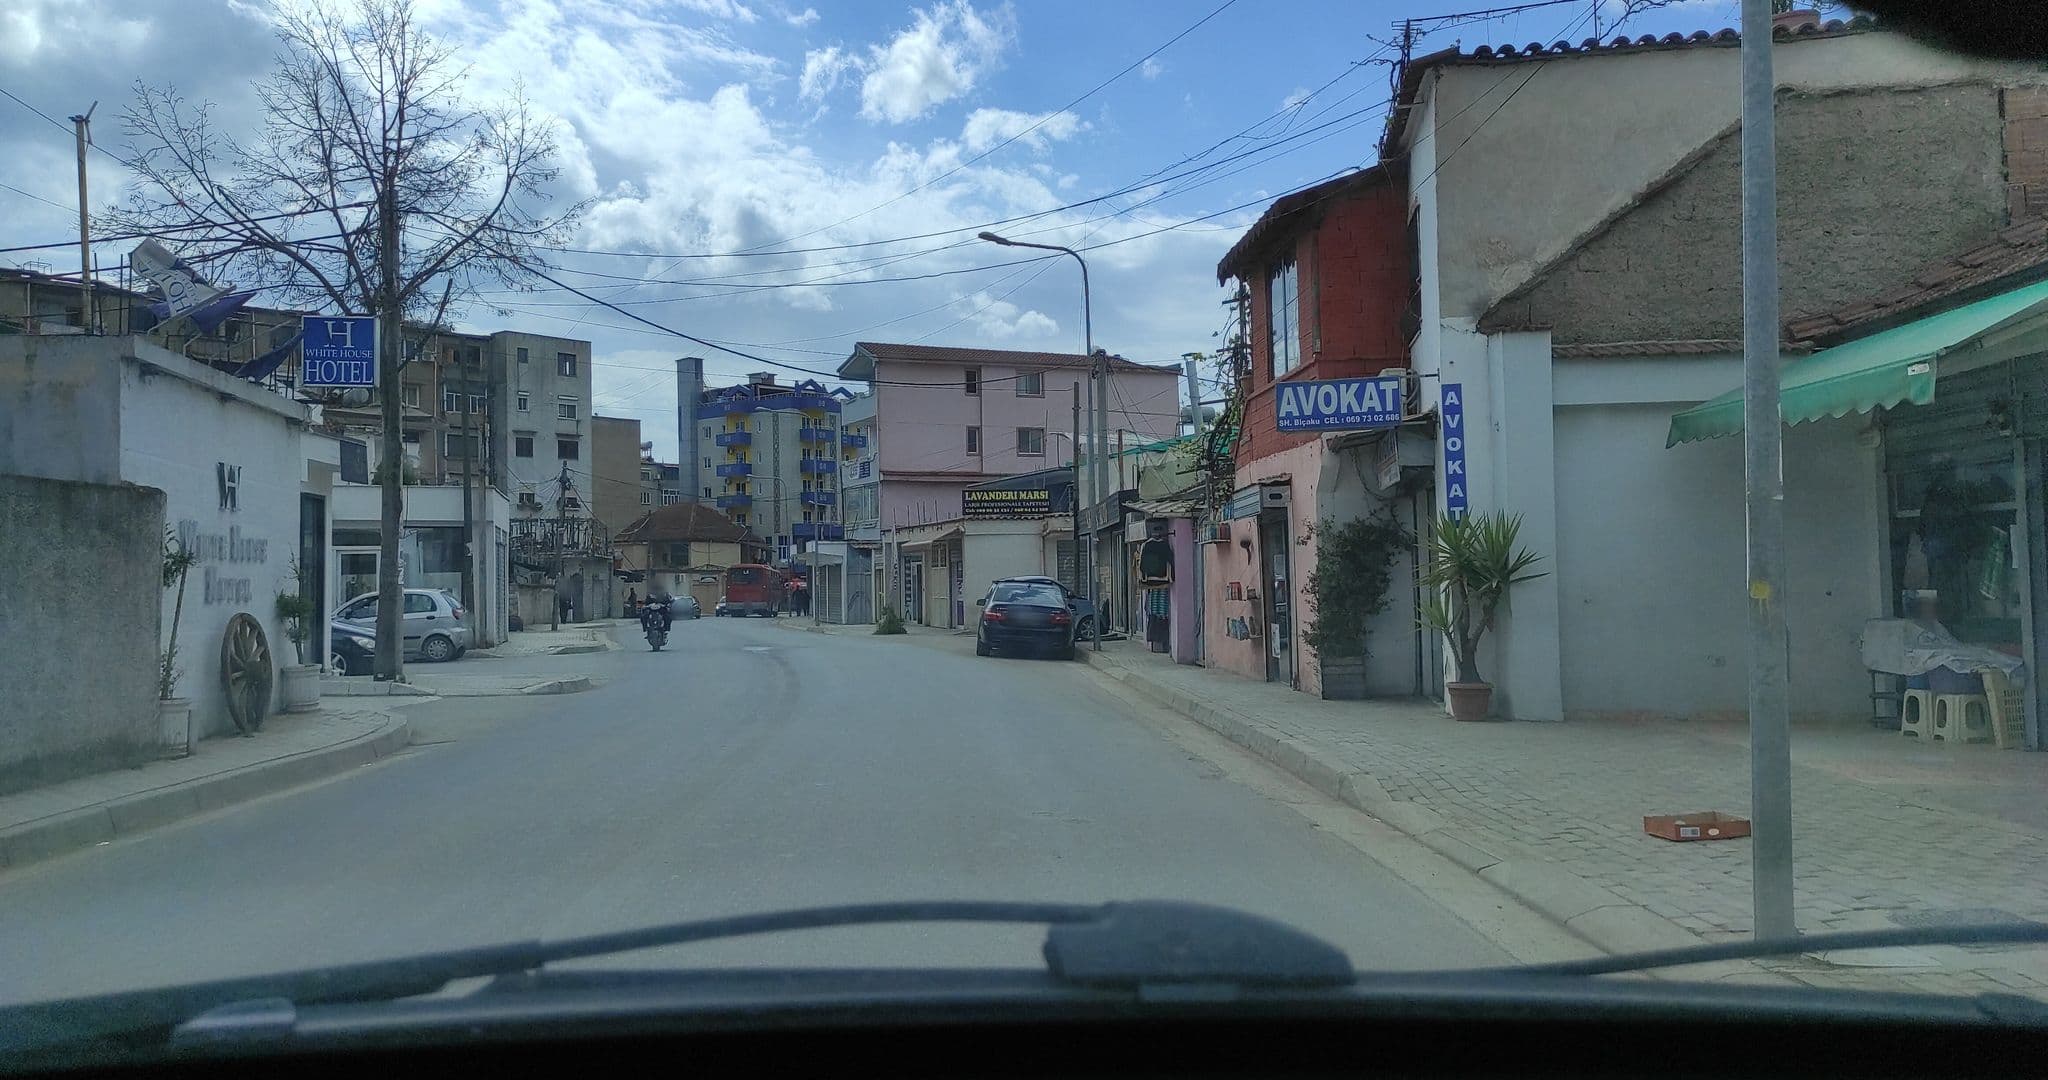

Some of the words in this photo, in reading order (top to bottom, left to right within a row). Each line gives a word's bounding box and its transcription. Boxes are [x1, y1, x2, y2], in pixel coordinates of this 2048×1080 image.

[305, 348, 338, 358] WHITE
[340, 349, 373, 359] HOUSE
[304, 360, 374, 383] HOTEL
[1279, 380, 1399, 418] AVOKAT
[1324, 416, 1340, 424] CEL
[1346, 415, 1361, 423] 069
[1362, 414, 1372, 423] 73
[1373, 413, 1384, 422] 02
[1444, 391, 1465, 521] AVOKAT
[965, 491, 1018, 501] LAVANDERI
[1020, 490, 1049, 500] MARSI
